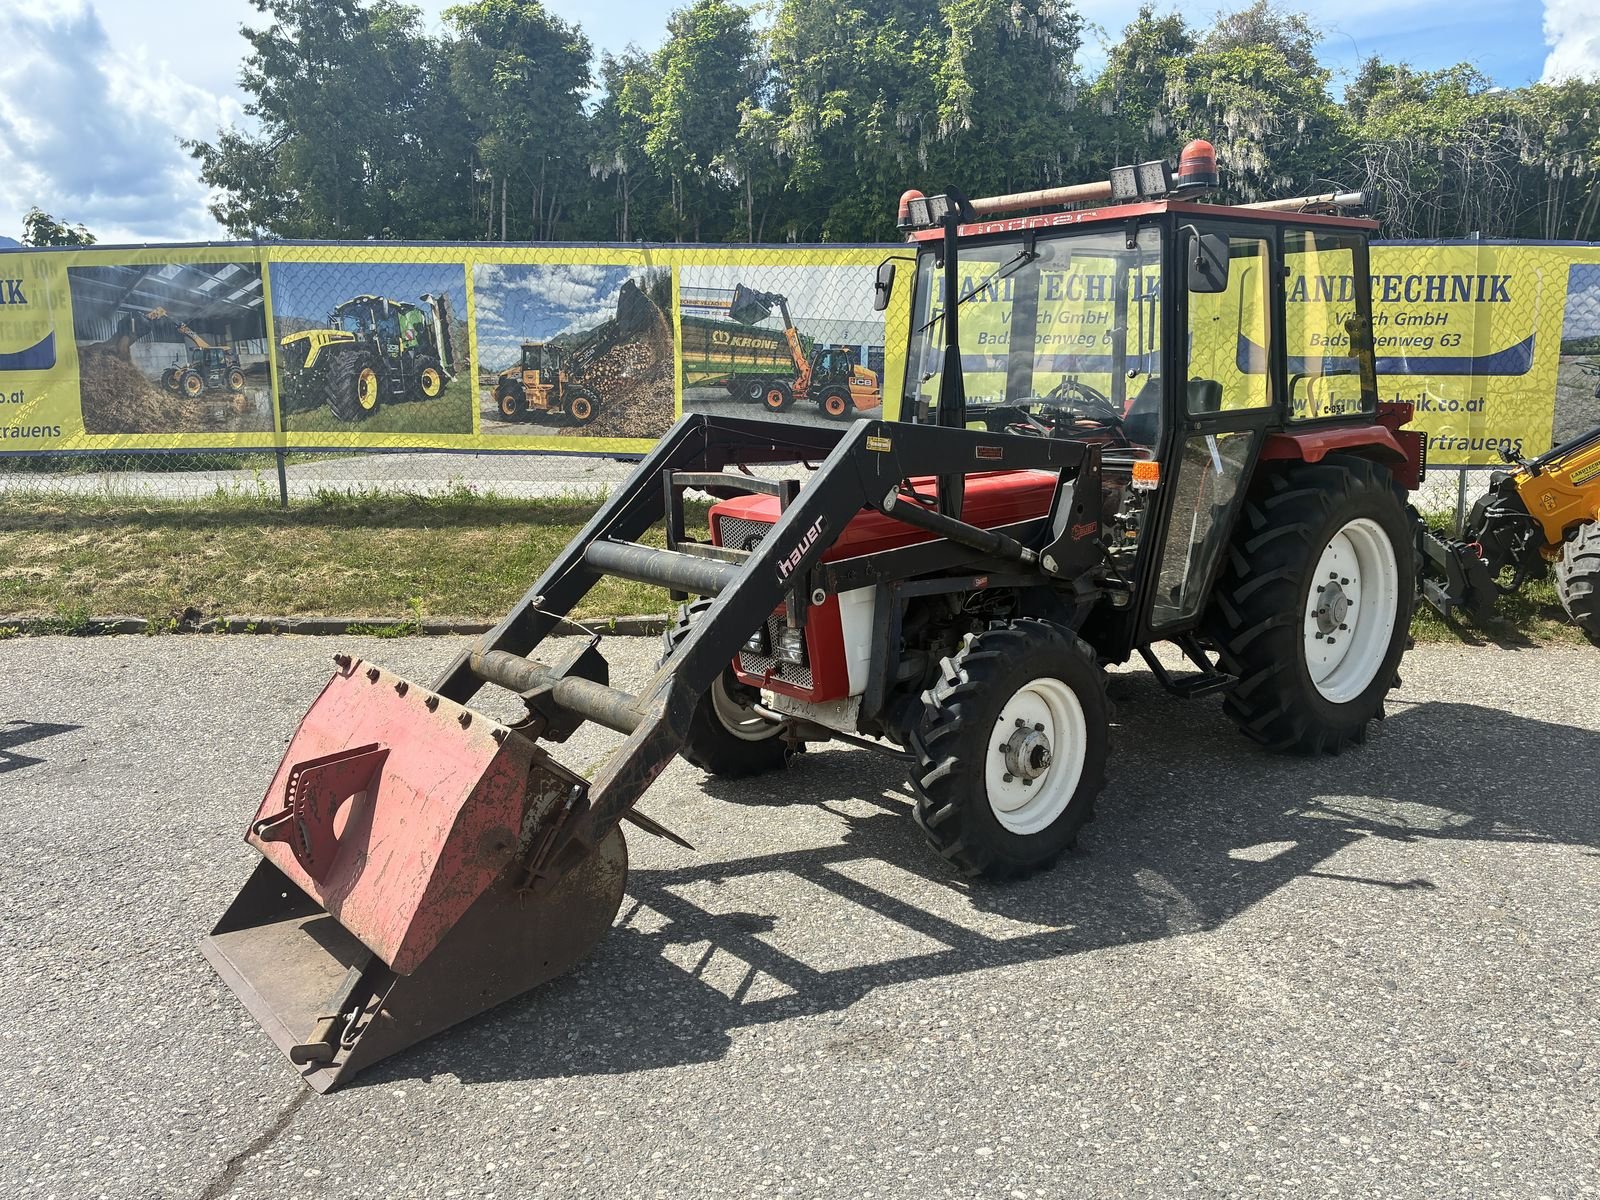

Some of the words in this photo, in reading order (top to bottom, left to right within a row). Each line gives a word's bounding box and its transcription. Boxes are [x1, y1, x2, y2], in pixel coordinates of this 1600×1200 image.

[957, 211, 1098, 237] Lindner
[1058, 311, 1109, 325] GmbH
[1394, 311, 1449, 326] GmbH
[729, 335, 779, 350] KRONE
[1102, 333, 1113, 345] 6
[1309, 332, 1434, 350] Badsenweg
[1439, 333, 1462, 347] 63
[850, 378, 872, 386] JCB
[0, 424, 61, 439] rauens
[1428, 436, 1524, 452] rtrauens
[779, 514, 824, 578] hauer
